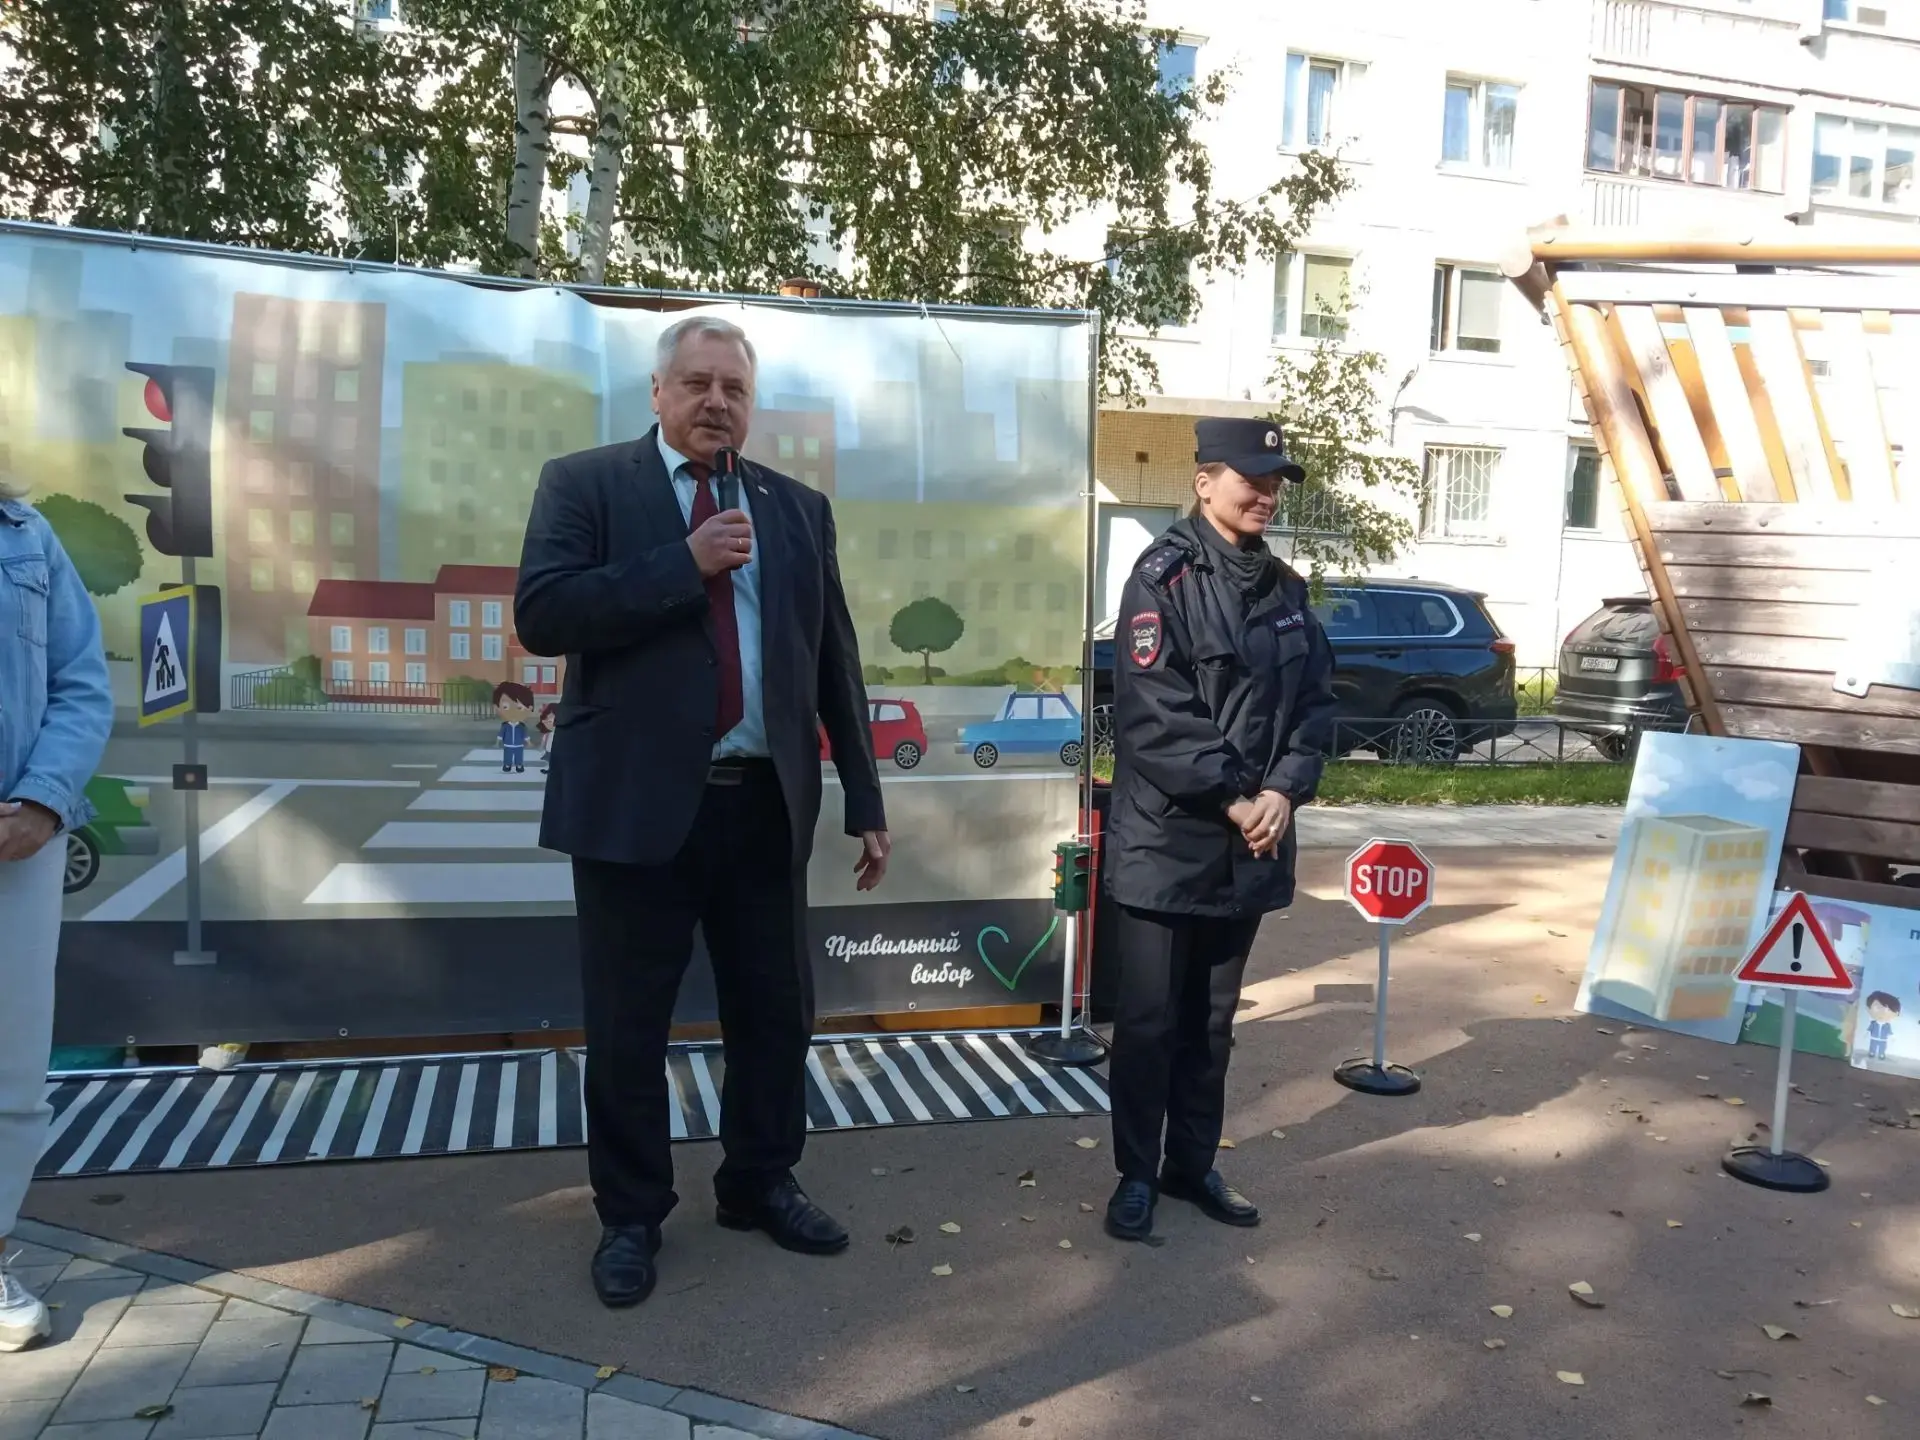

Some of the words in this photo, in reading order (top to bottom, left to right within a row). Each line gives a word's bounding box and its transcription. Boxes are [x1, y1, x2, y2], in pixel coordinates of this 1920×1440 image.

[1355, 864, 1423, 898] STOP
[825, 930, 961, 963] Правильный
[911, 962, 974, 988] выбор
